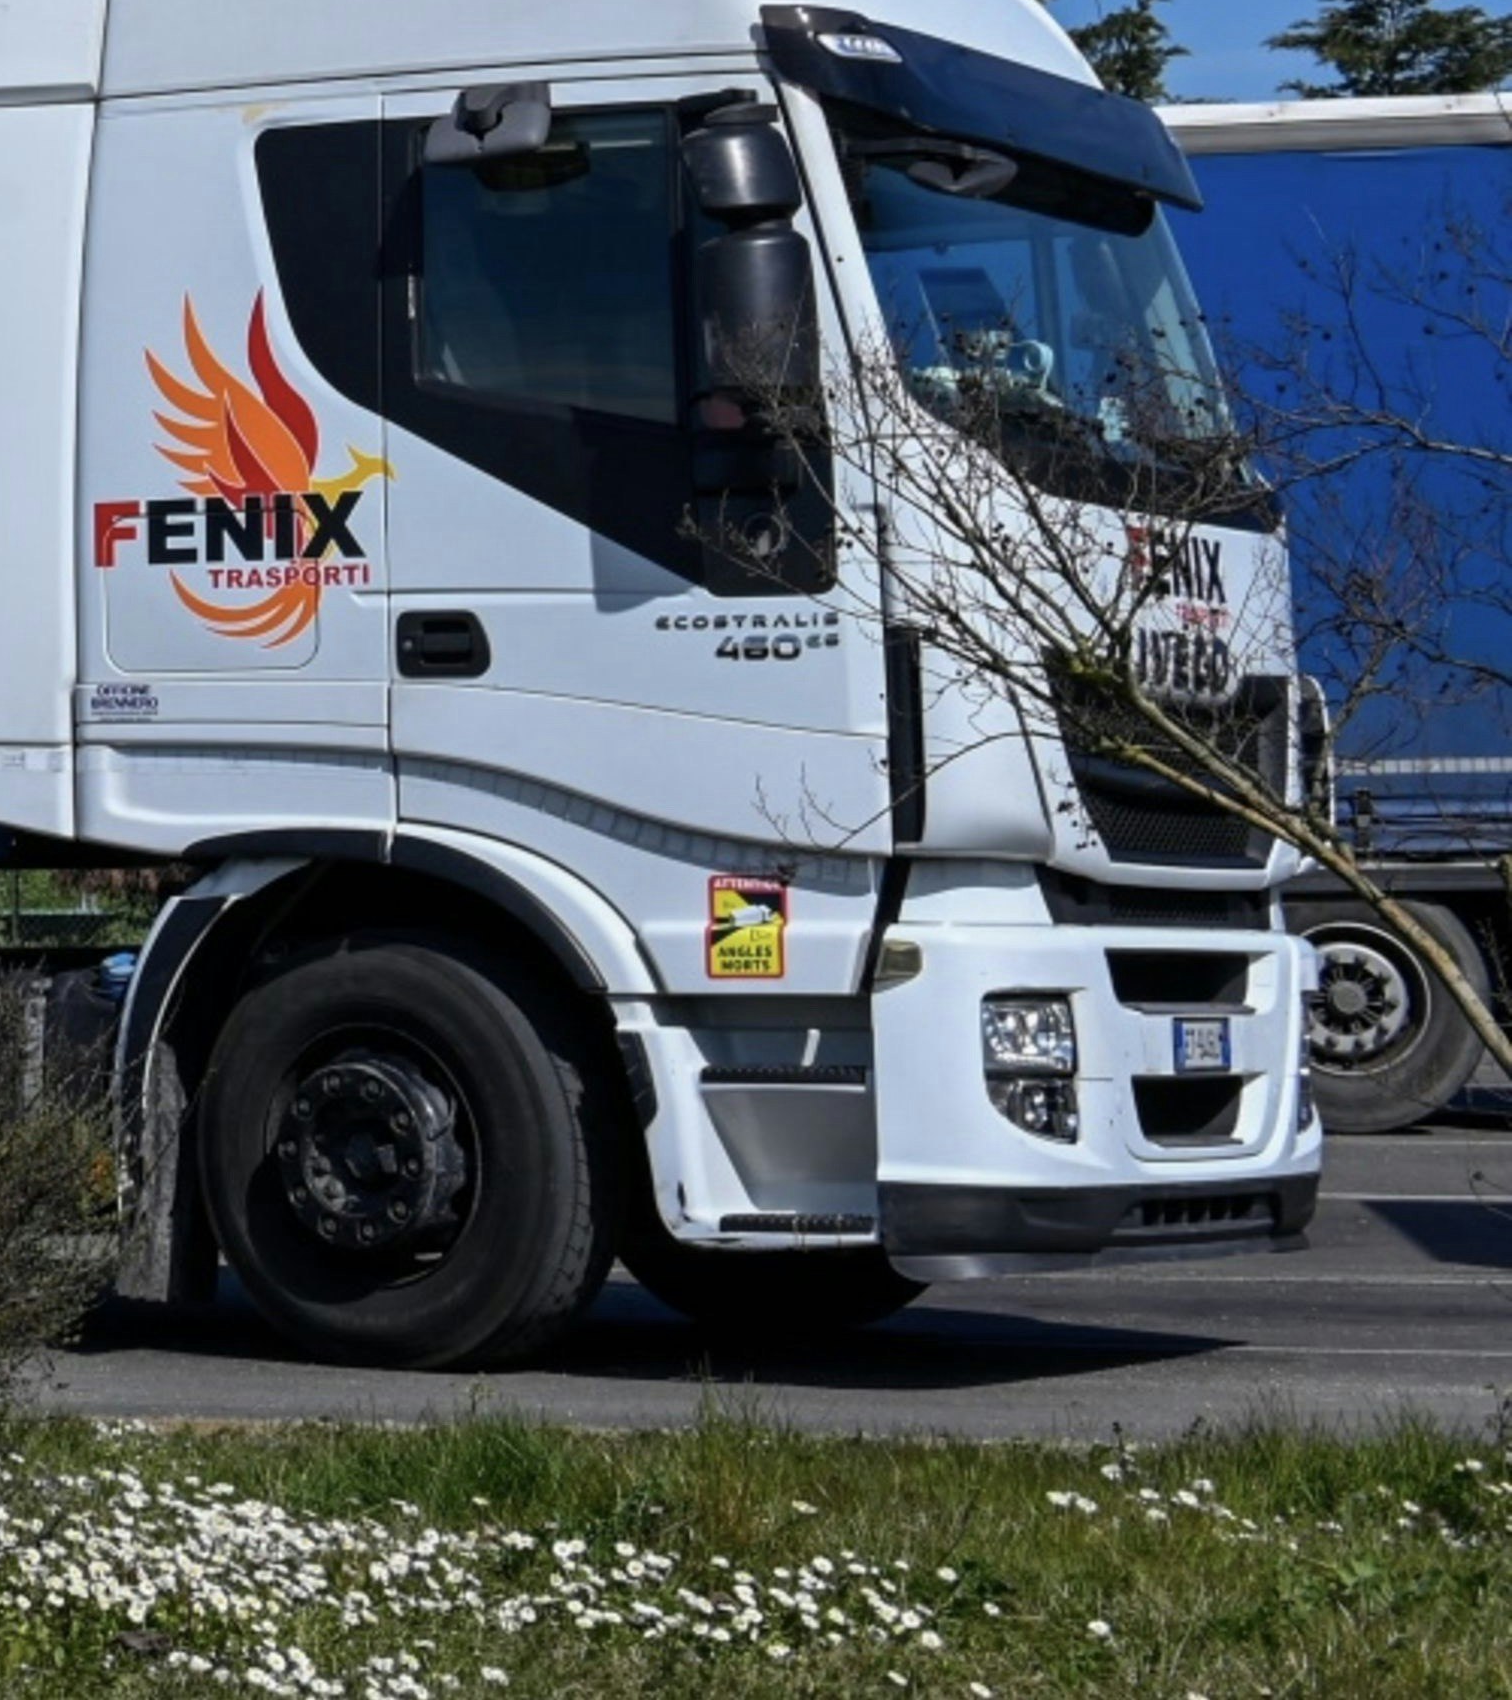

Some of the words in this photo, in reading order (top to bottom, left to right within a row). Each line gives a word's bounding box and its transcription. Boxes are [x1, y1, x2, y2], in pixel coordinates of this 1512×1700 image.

[93, 491, 367, 568] FENIX
[208, 564, 370, 589] TRASPORTI
[717, 944, 773, 958] ANGLES
[720, 960, 771, 971] MORTS
